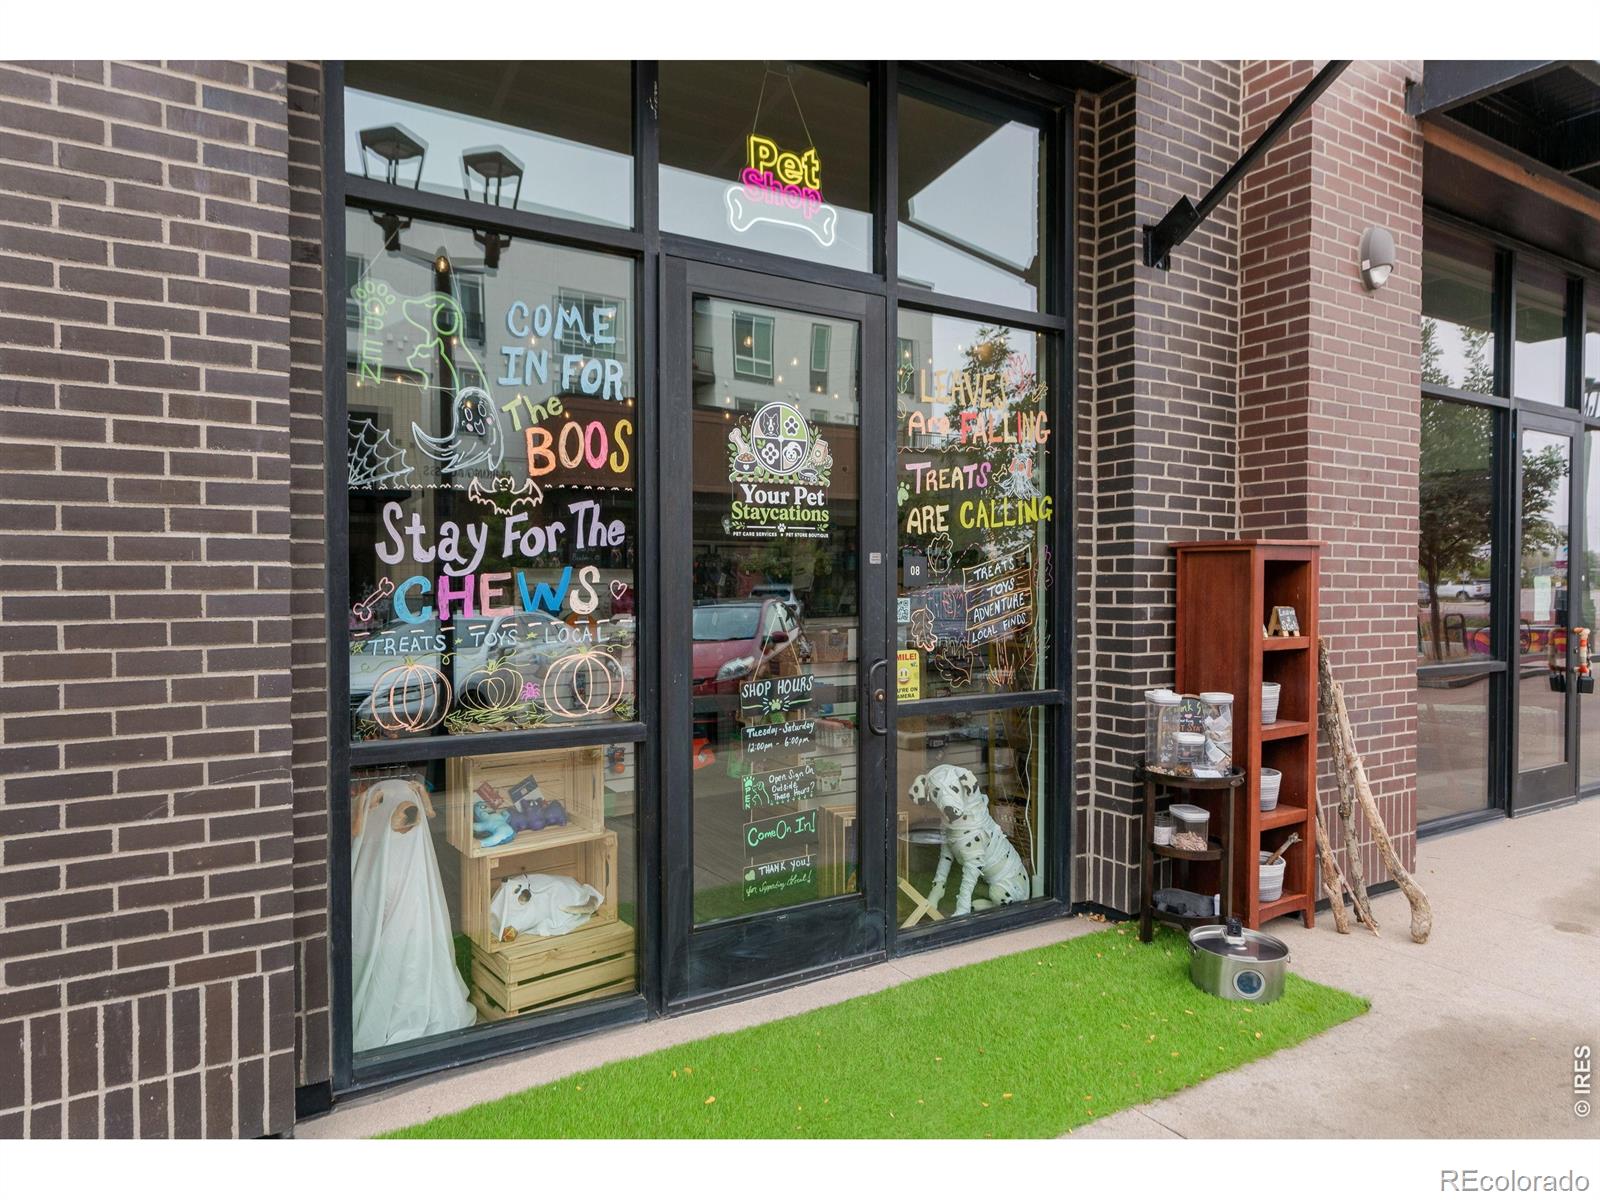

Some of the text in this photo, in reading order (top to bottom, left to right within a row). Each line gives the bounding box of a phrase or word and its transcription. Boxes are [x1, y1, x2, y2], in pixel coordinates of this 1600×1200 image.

[750, 135, 820, 190] Pet
[742, 167, 823, 220] Shop
[507, 300, 617, 344] COME
[498, 346, 624, 401] IN FOR
[921, 368, 1009, 410] LEAVES
[501, 395, 563, 432] The
[959, 410, 1051, 445] FALLING
[525, 419, 632, 476] BOOS
[905, 461, 992, 495] TREATS
[740, 483, 824, 506] Your Pet
[731, 501, 830, 525] Staycations
[906, 495, 1053, 536] ARE CALLING
[374, 500, 625, 576] Stay For The
[910, 566, 920, 576] 08
[973, 557, 1015, 580] TREATS
[393, 564, 601, 624] CHEWS
[987, 577, 1016, 597] TOYS
[973, 592, 1025, 623] ADVENTURE
[368, 626, 610, 656] TREATS TOYS LOCAL
[972, 612, 1027, 643] LOCAL FINDS
[897, 653, 917, 661] MILE!
[742, 675, 814, 698] SHOP HOURS
[747, 742, 773, 753] 12:00pm
[784, 736, 810, 747] 6:00pm
[768, 765, 815, 784] Open Sign On
[771, 781, 798, 793] Outside
[747, 811, 816, 847] Come On In!
[758, 860, 786, 876] THANK
